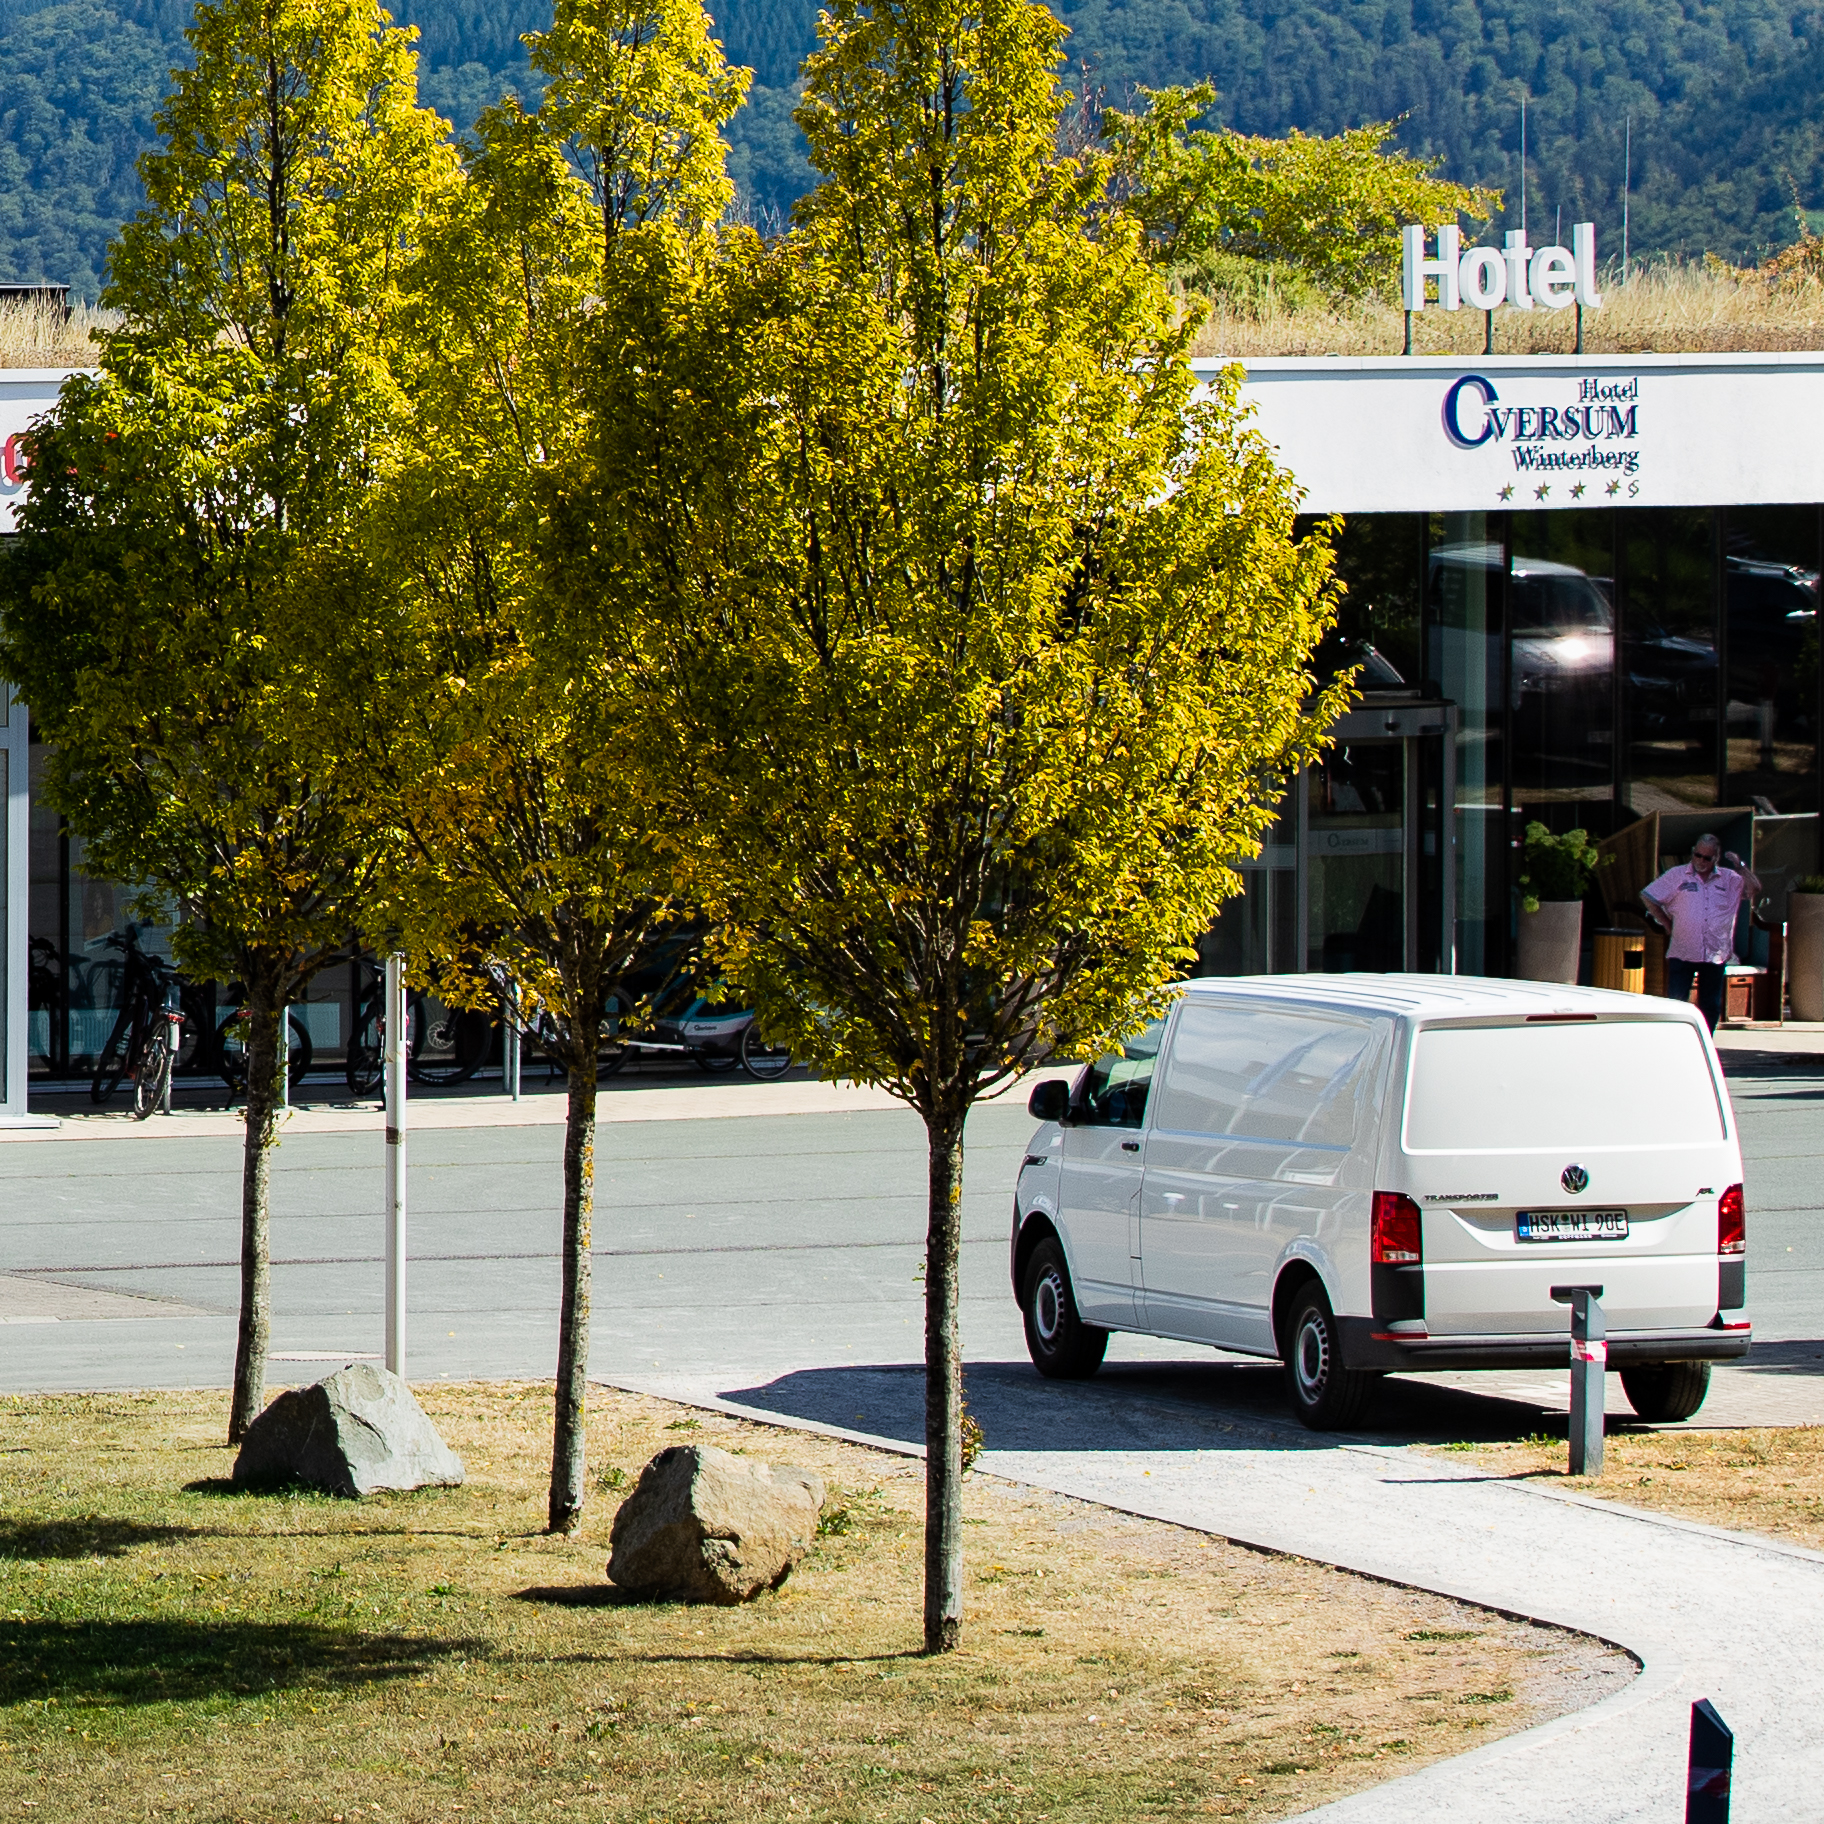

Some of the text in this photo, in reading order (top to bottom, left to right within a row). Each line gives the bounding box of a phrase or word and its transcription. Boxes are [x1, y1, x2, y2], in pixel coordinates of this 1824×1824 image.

[1403, 221, 1601, 311] Hotel
[1580, 376, 1639, 399] Hotel
[1515, 444, 1640, 473] Winterberg
[1423, 1193, 1499, 1202] TRANSPORTER
[1528, 1214, 1560, 1233] HSK
[1594, 1212, 1625, 1232] 90E
